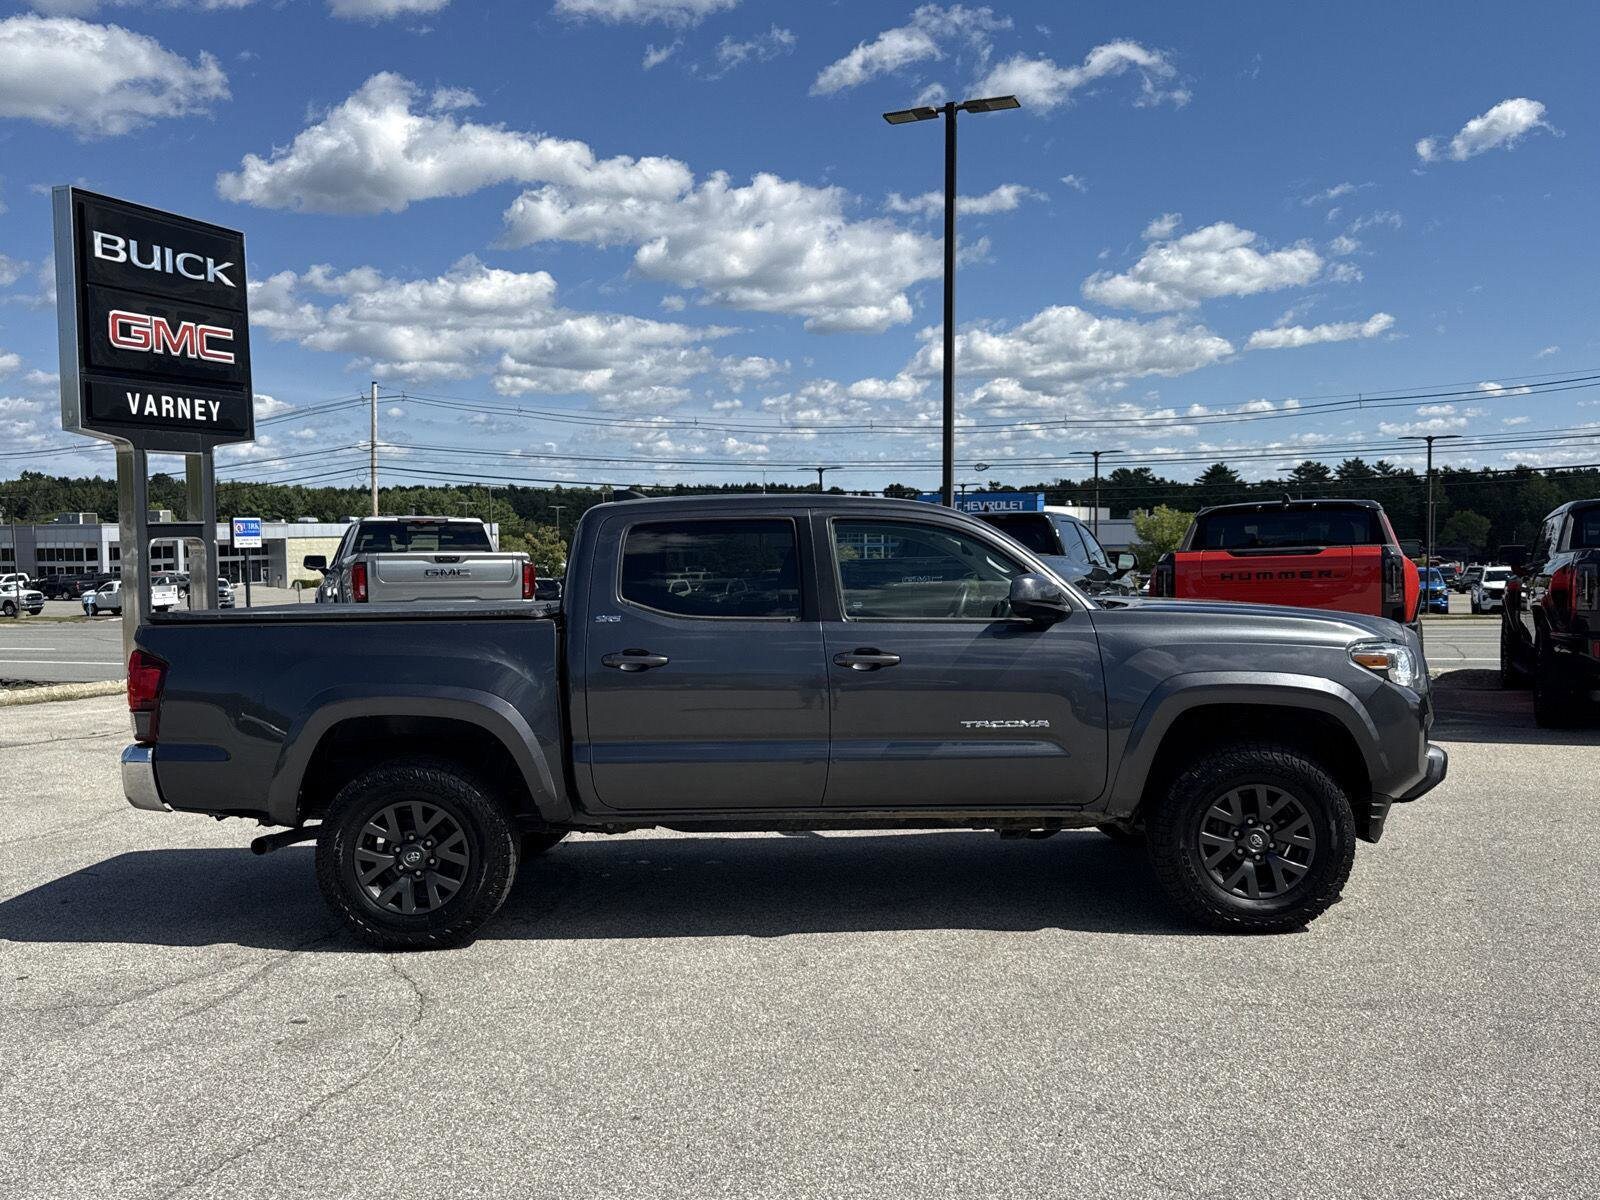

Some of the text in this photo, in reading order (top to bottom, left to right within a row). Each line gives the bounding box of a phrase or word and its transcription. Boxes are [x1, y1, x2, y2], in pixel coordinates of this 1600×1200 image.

[93, 230, 237, 288] BUICK
[108, 309, 235, 364] GMC
[126, 392, 220, 421] VARNEY
[954, 500, 1024, 513] CHEVROLET
[424, 567, 472, 578] GMC
[1220, 569, 1332, 582] HUMMER
[960, 719, 1050, 728] TACOMA
